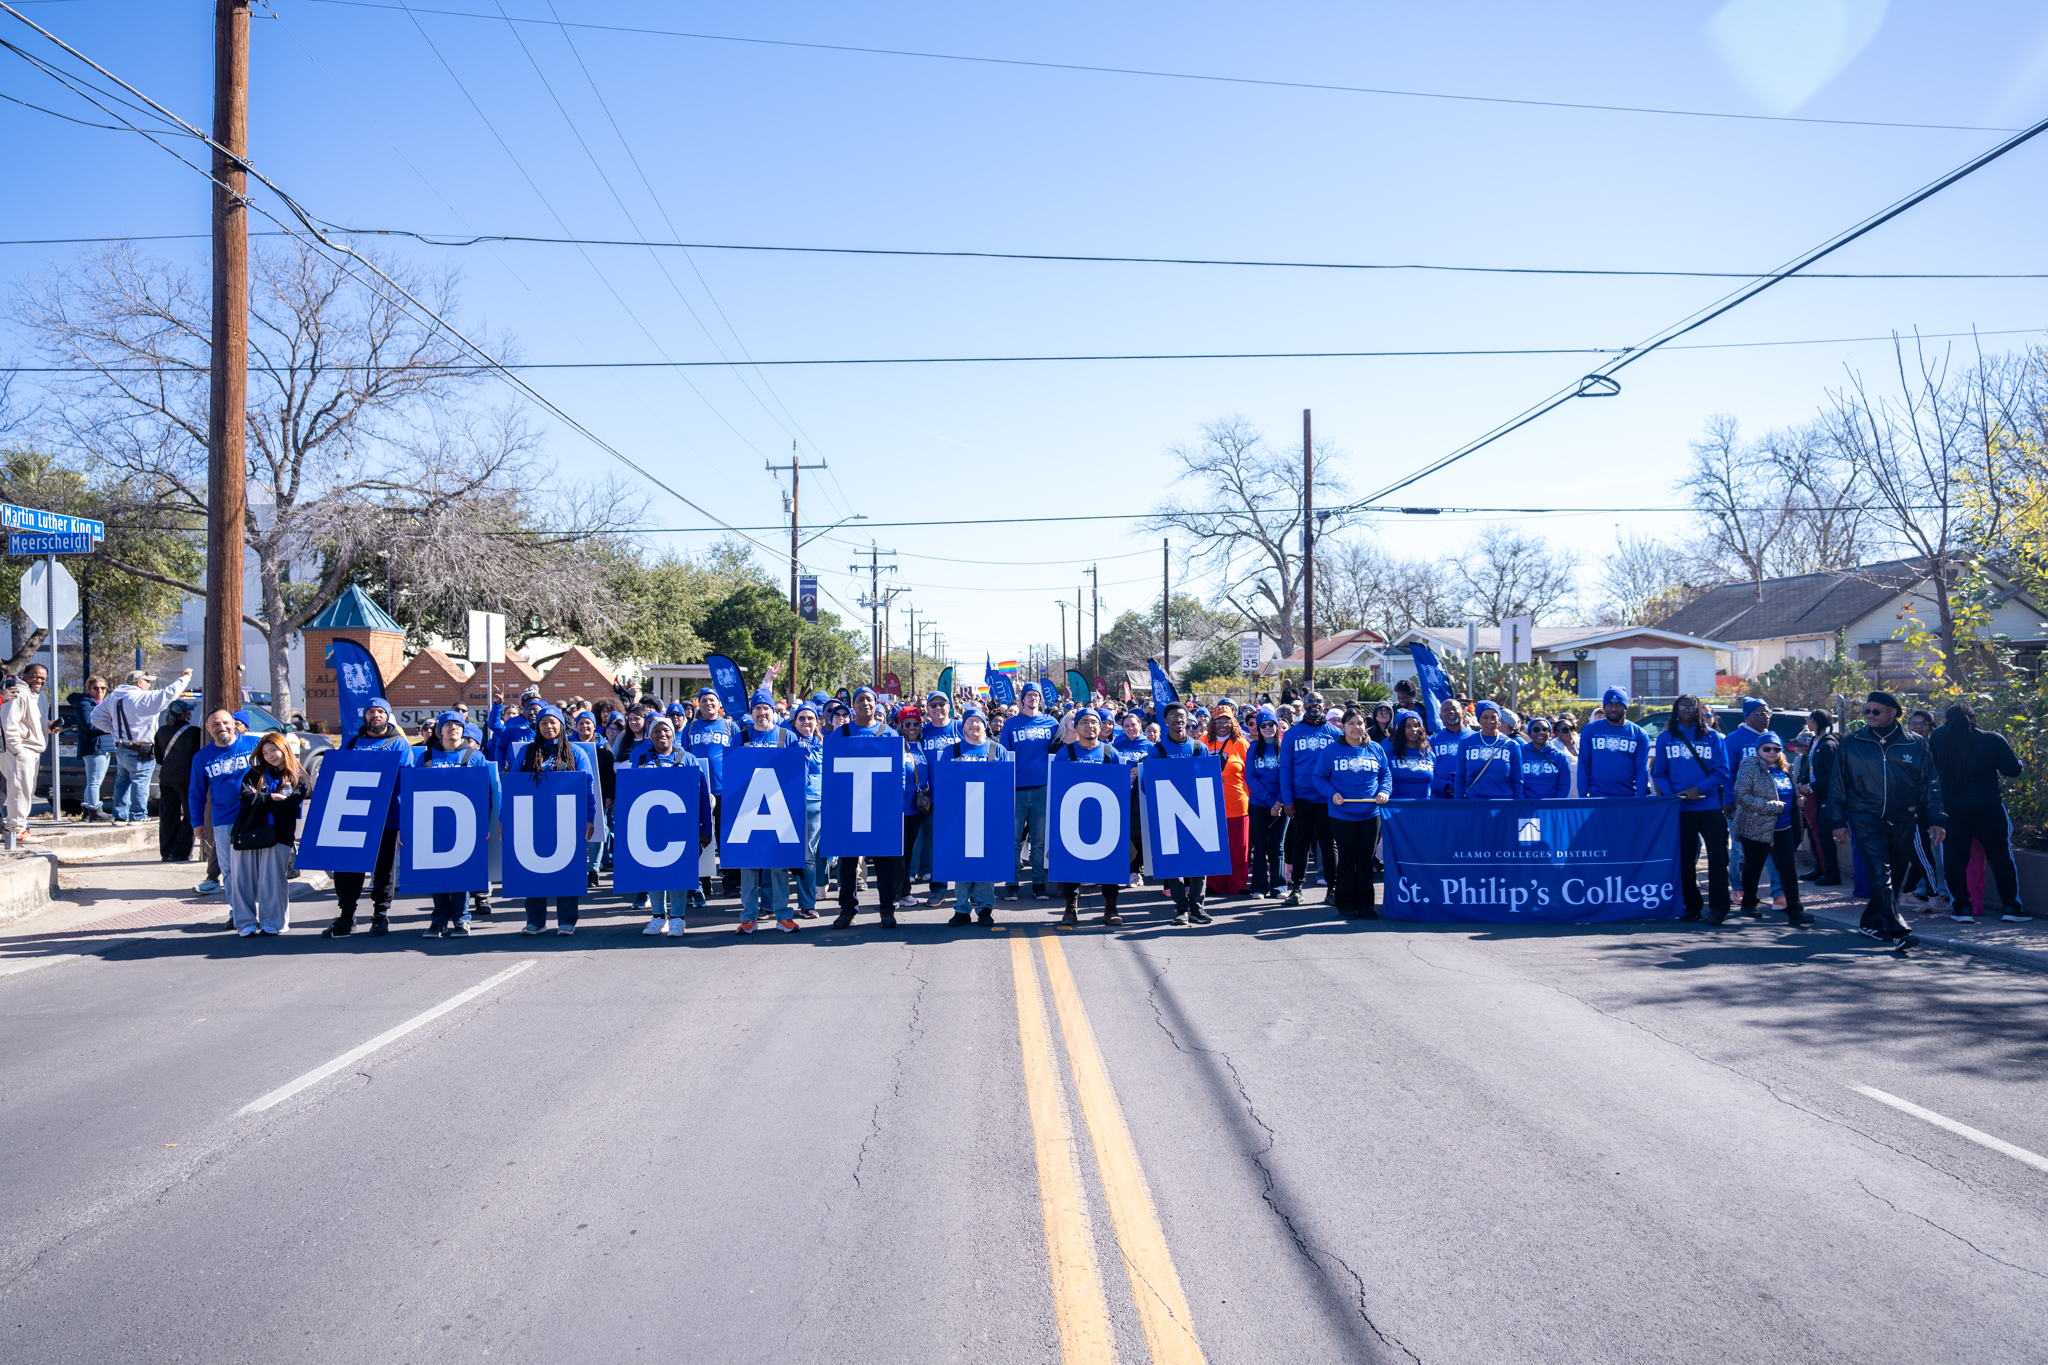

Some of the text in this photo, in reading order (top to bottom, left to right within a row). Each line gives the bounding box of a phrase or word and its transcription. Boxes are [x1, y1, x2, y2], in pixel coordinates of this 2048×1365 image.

[5, 506, 35, 526] Martin
[38, 512, 68, 531] Luther
[94, 524, 101, 534] Dr
[11, 533, 87, 551] Meerscheidt
[1243, 659, 1259, 668] 35
[306, 688, 339, 698] COLL
[962, 686, 972, 699] R
[1453, 850, 1608, 859] ALAMO COLLEGES DISTRICT
[1397, 875, 1674, 913] St. Philip's College
